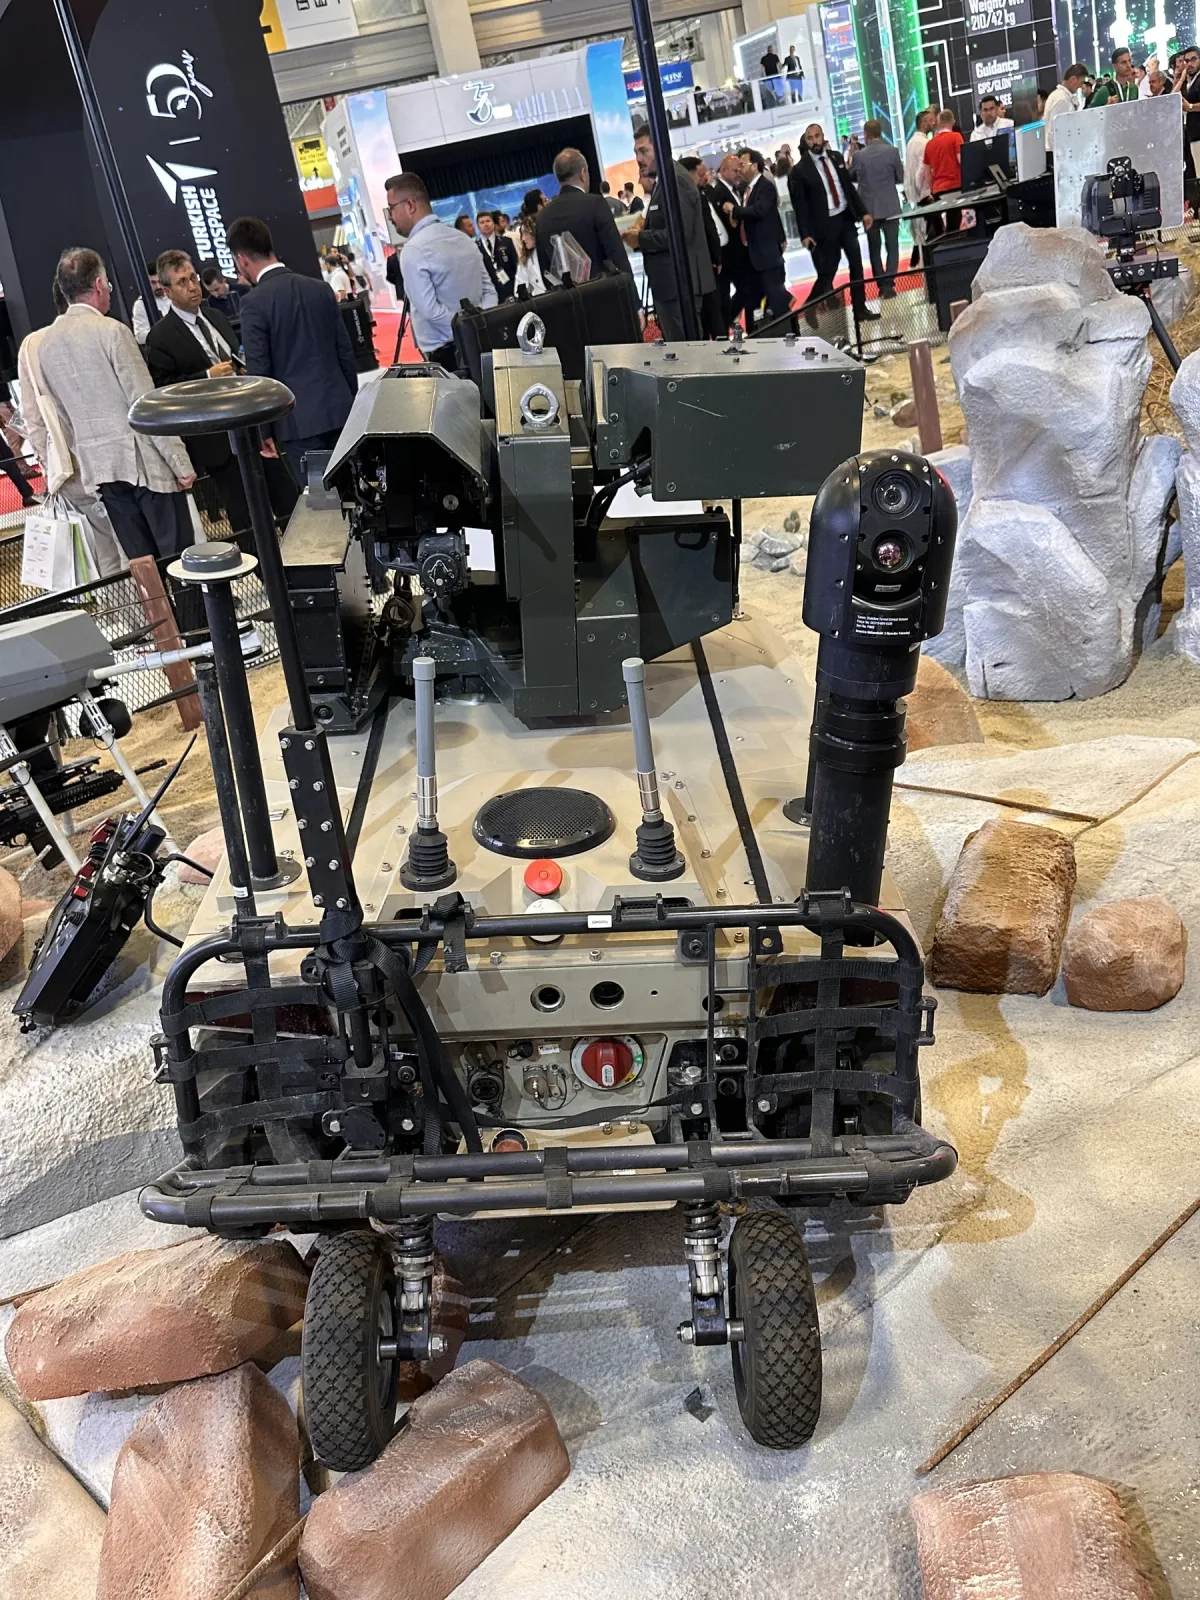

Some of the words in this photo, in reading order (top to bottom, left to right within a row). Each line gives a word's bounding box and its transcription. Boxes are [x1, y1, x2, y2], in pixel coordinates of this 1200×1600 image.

[970, 9, 1003, 31] 210/42
[1003, 8, 1016, 26] kg
[975, 59, 1020, 79] Guidance
[181, 185, 215, 261] TURKISH
[200, 187, 238, 280] AEROSPACE
